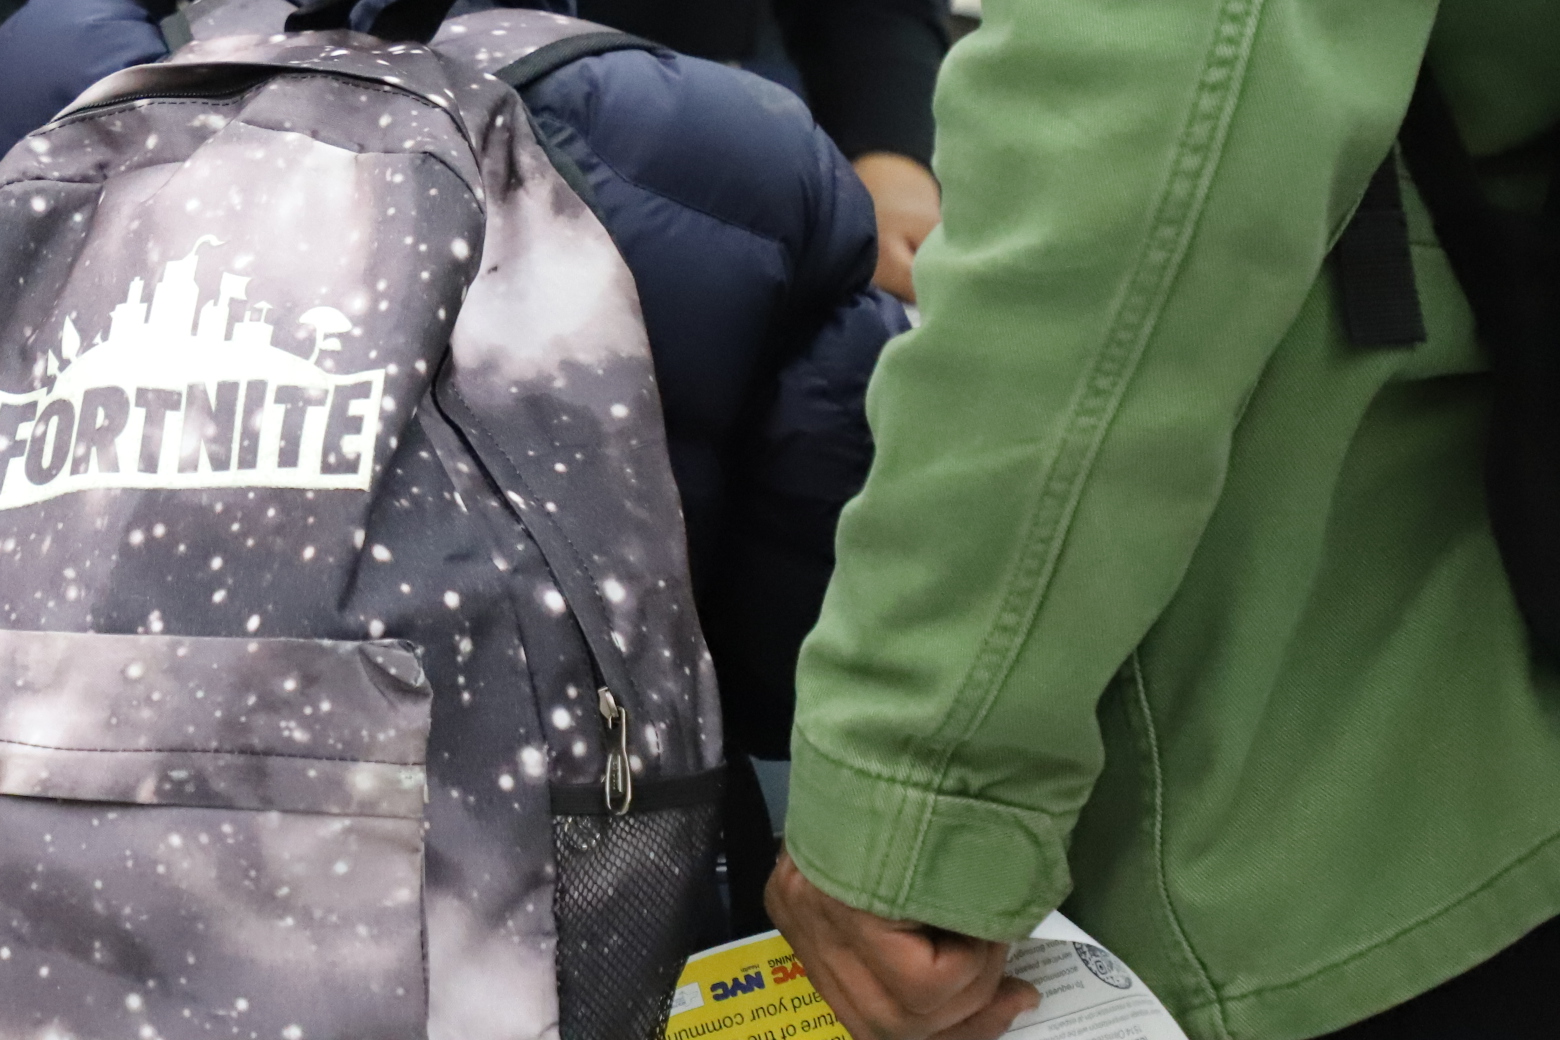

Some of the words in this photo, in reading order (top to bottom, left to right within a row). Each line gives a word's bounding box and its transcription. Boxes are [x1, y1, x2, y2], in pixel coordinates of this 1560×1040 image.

[771, 961, 807, 985] YC
[710, 970, 765, 1002] NYC
[750, 996, 789, 1023] your
[790, 991, 824, 1015] and
[782, 1023, 797, 1040] of
